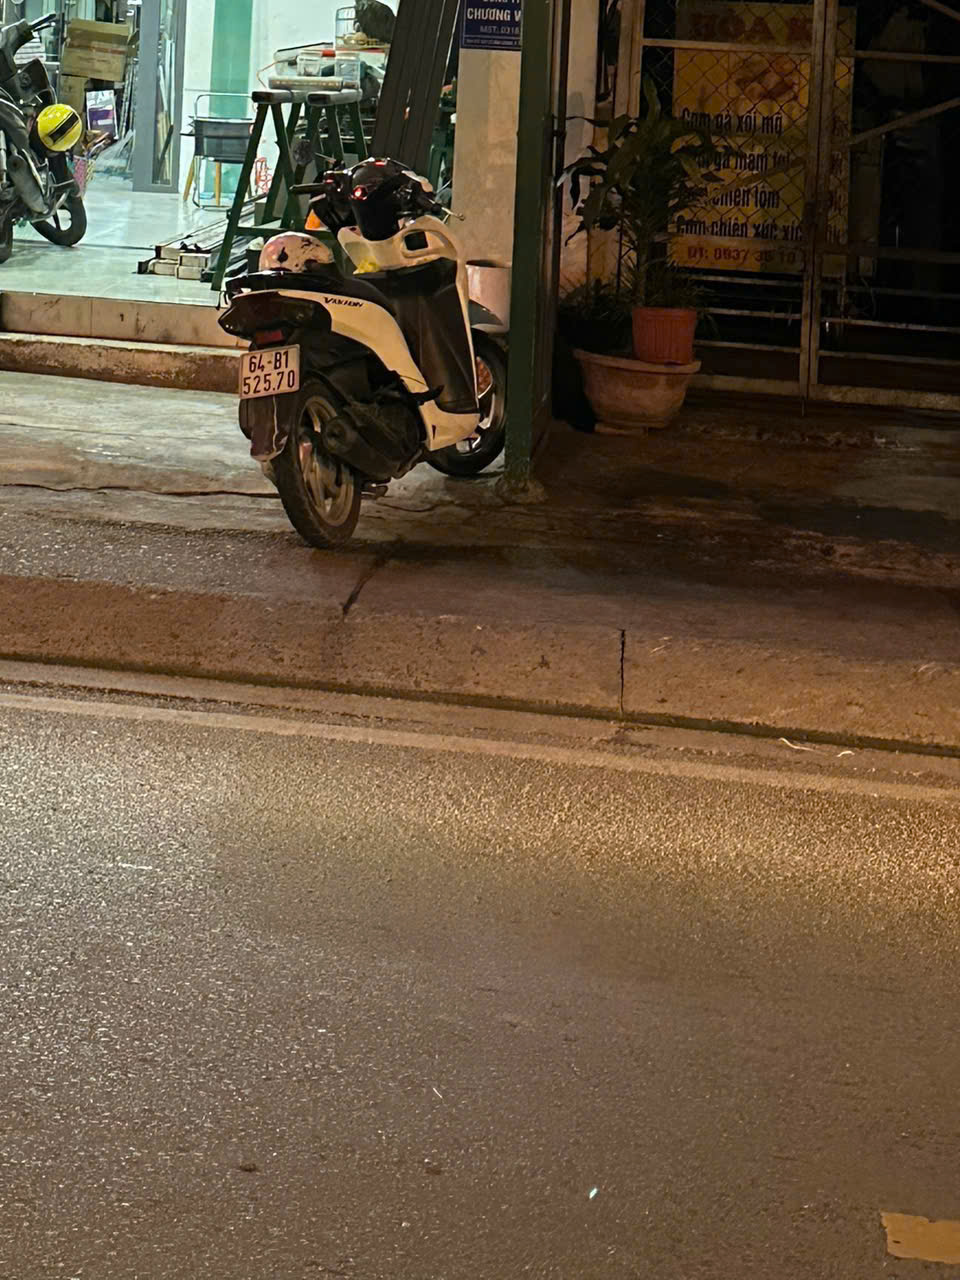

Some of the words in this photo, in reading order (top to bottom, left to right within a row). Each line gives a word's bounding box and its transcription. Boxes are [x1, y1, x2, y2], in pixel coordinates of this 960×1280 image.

[467, 7, 511, 21] CHƯƠNG
[249, 350, 289, 373] 64-B1
[243, 369, 295, 395] 525.70
